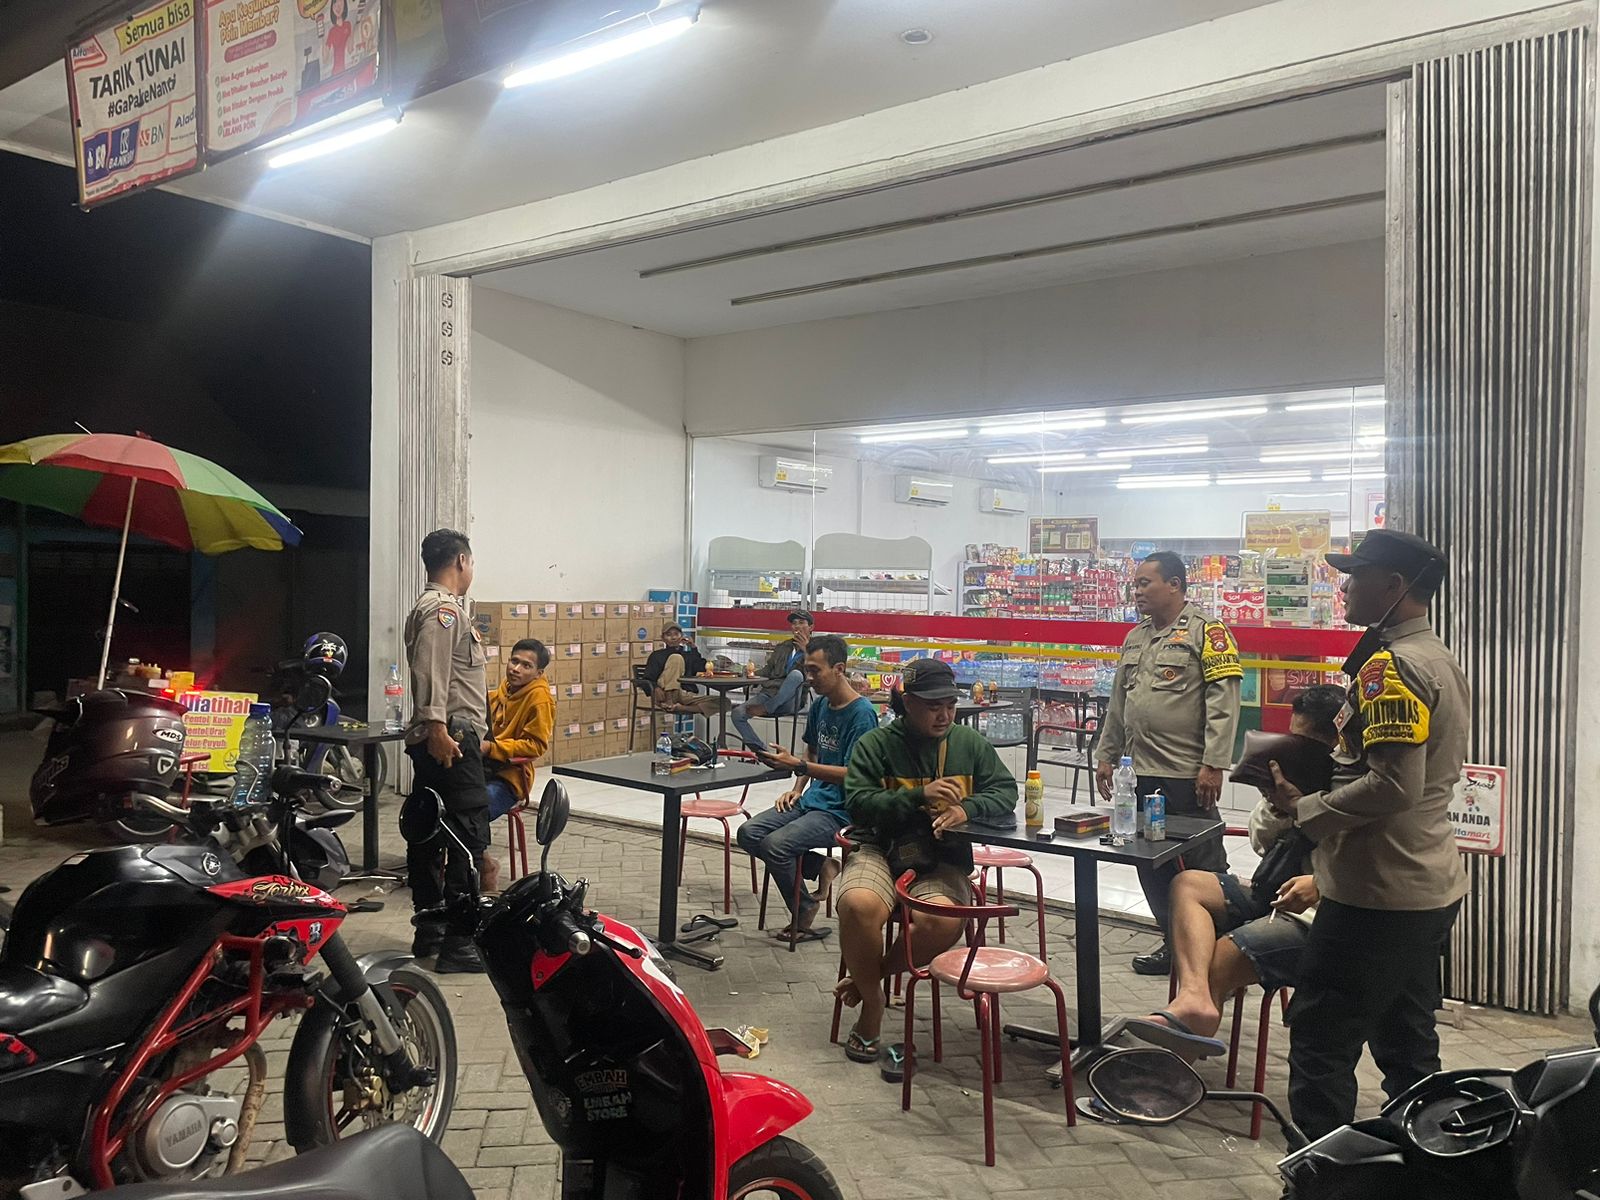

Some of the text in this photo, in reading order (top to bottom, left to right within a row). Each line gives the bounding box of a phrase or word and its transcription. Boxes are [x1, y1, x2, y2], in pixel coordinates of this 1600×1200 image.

[125, 2, 190, 45] Semua bisa
[219, 10, 238, 27] Apa
[220, 25, 239, 46] Poin
[239, 5, 280, 38] Member?
[89, 61, 135, 99] TARIK
[136, 36, 185, 81] TUNAI
[108, 73, 176, 118] #GaPakeNanti
[160, 731, 182, 742] MDS
[1462, 812, 1491, 827] ANDA
[1454, 827, 1491, 840] lfamart
[165, 1120, 202, 1147] YAMAHA
